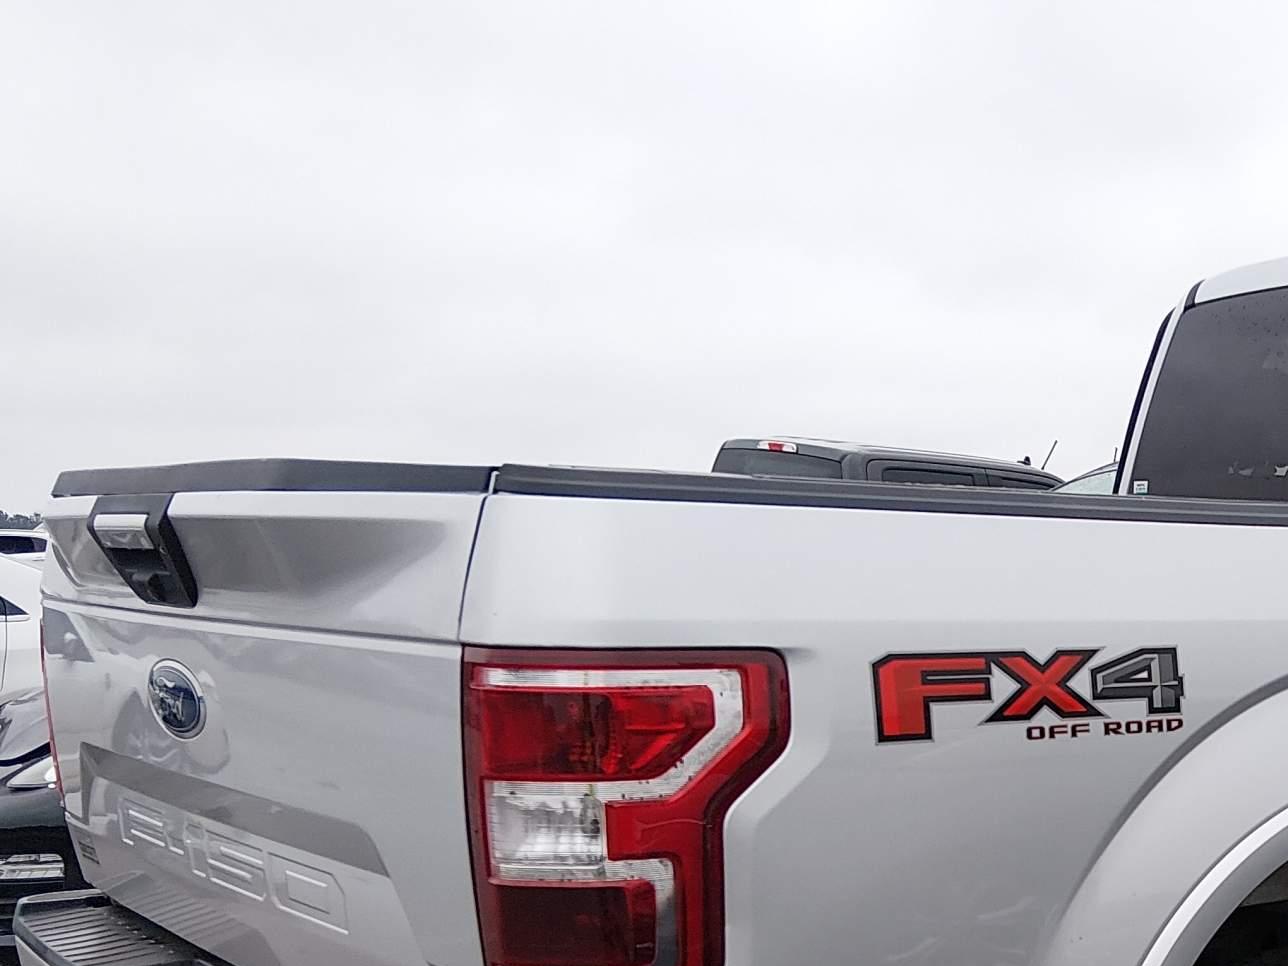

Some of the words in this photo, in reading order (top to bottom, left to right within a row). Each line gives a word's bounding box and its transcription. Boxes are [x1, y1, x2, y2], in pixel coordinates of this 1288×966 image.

[870, 645, 1185, 745] FX4
[1026, 723, 1091, 740] OFF
[1103, 718, 1184, 736] ROAD
